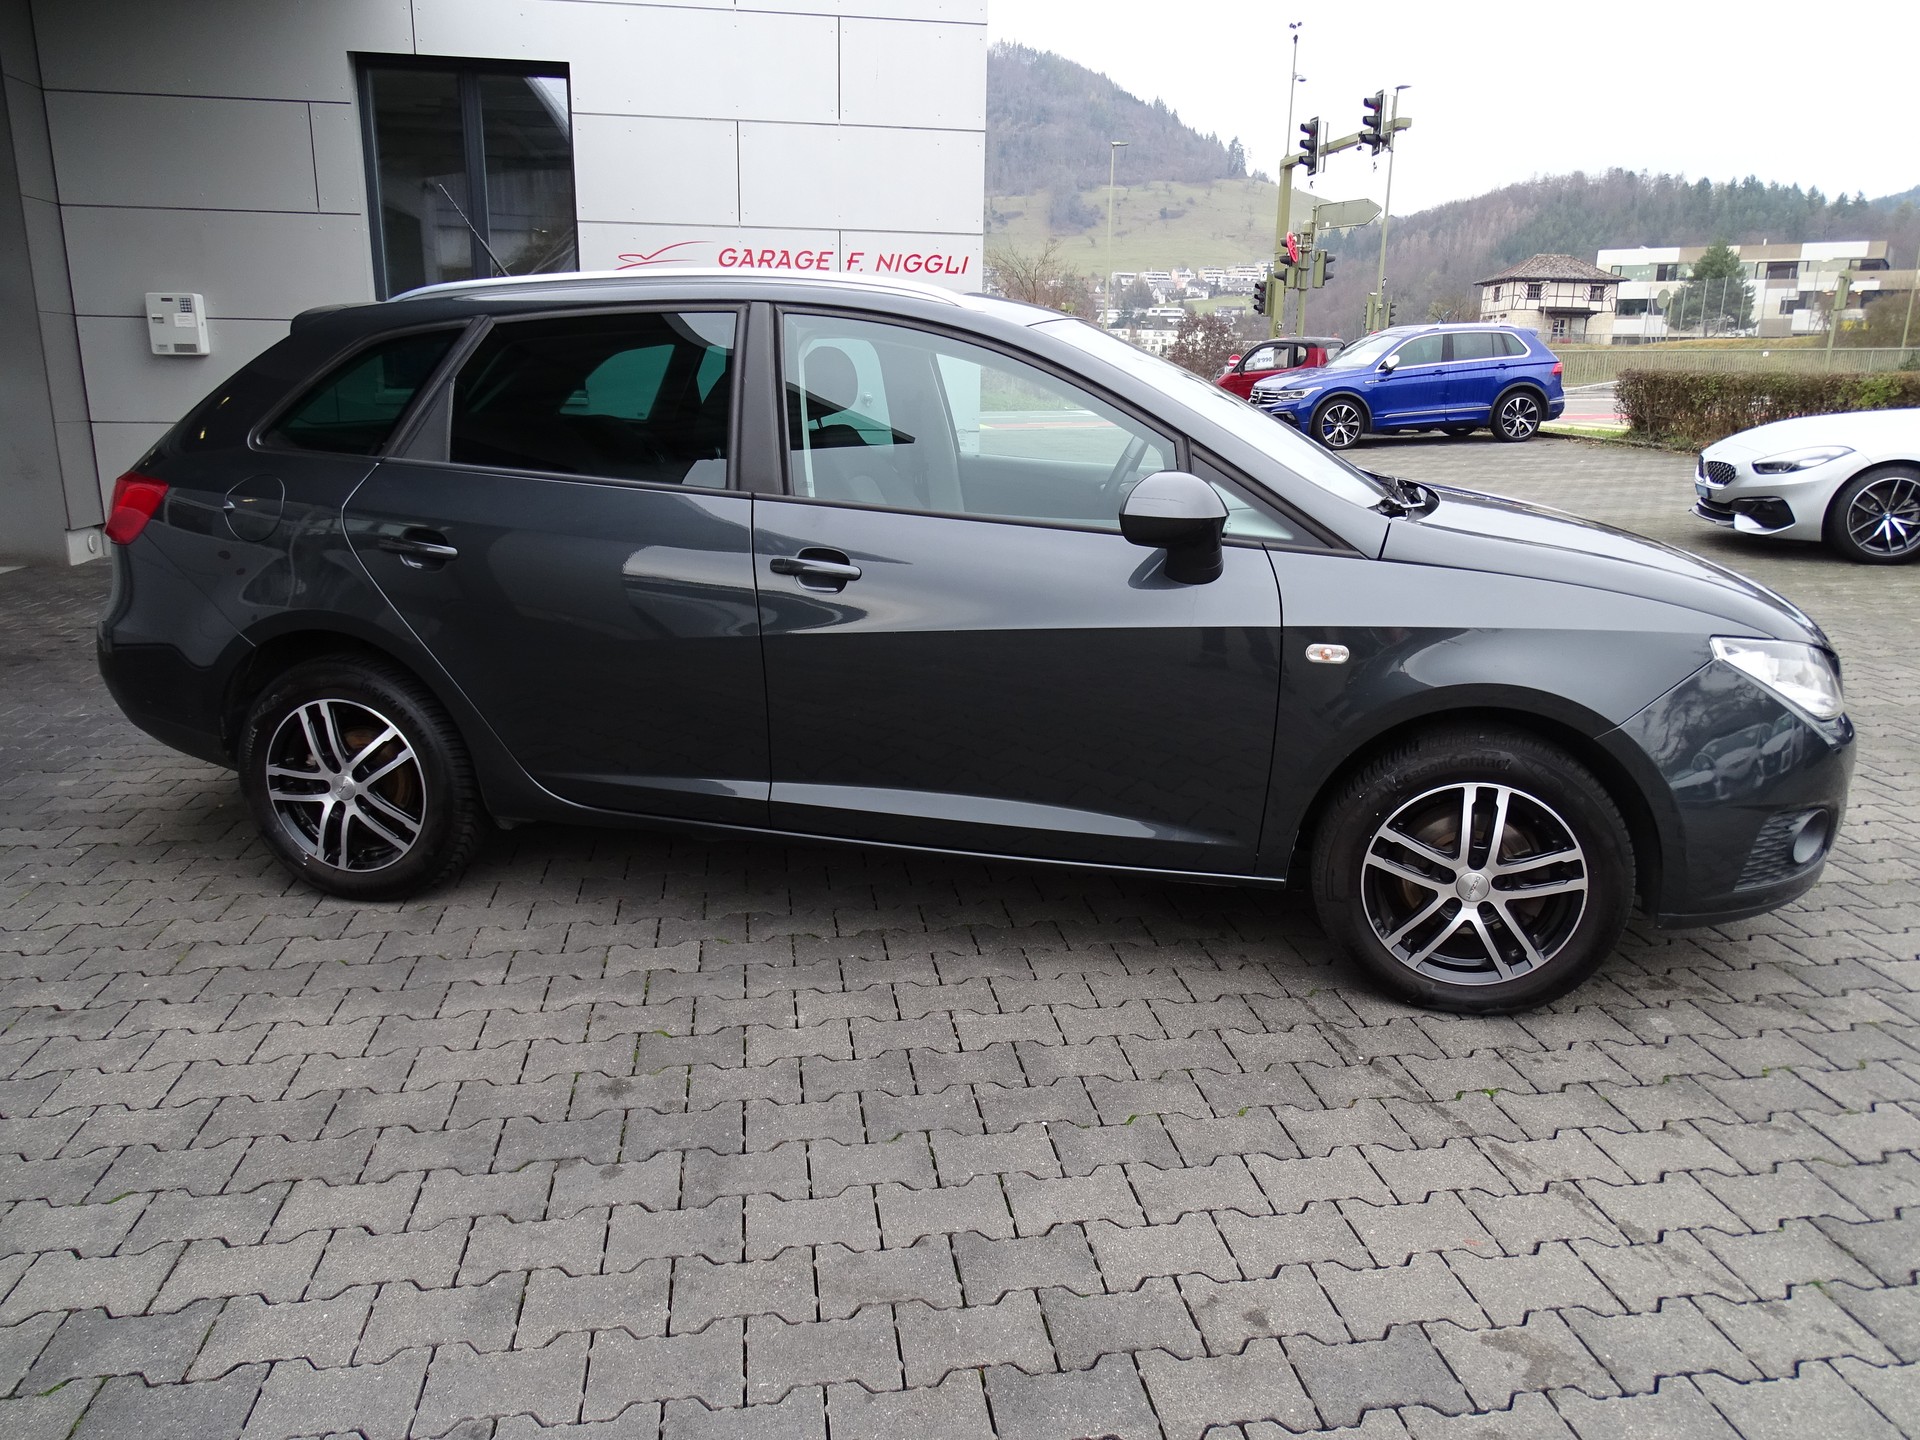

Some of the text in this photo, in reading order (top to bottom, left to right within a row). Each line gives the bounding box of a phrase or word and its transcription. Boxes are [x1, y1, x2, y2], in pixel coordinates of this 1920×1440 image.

[718, 248, 970, 275] GARAGE F. NIGGLI
